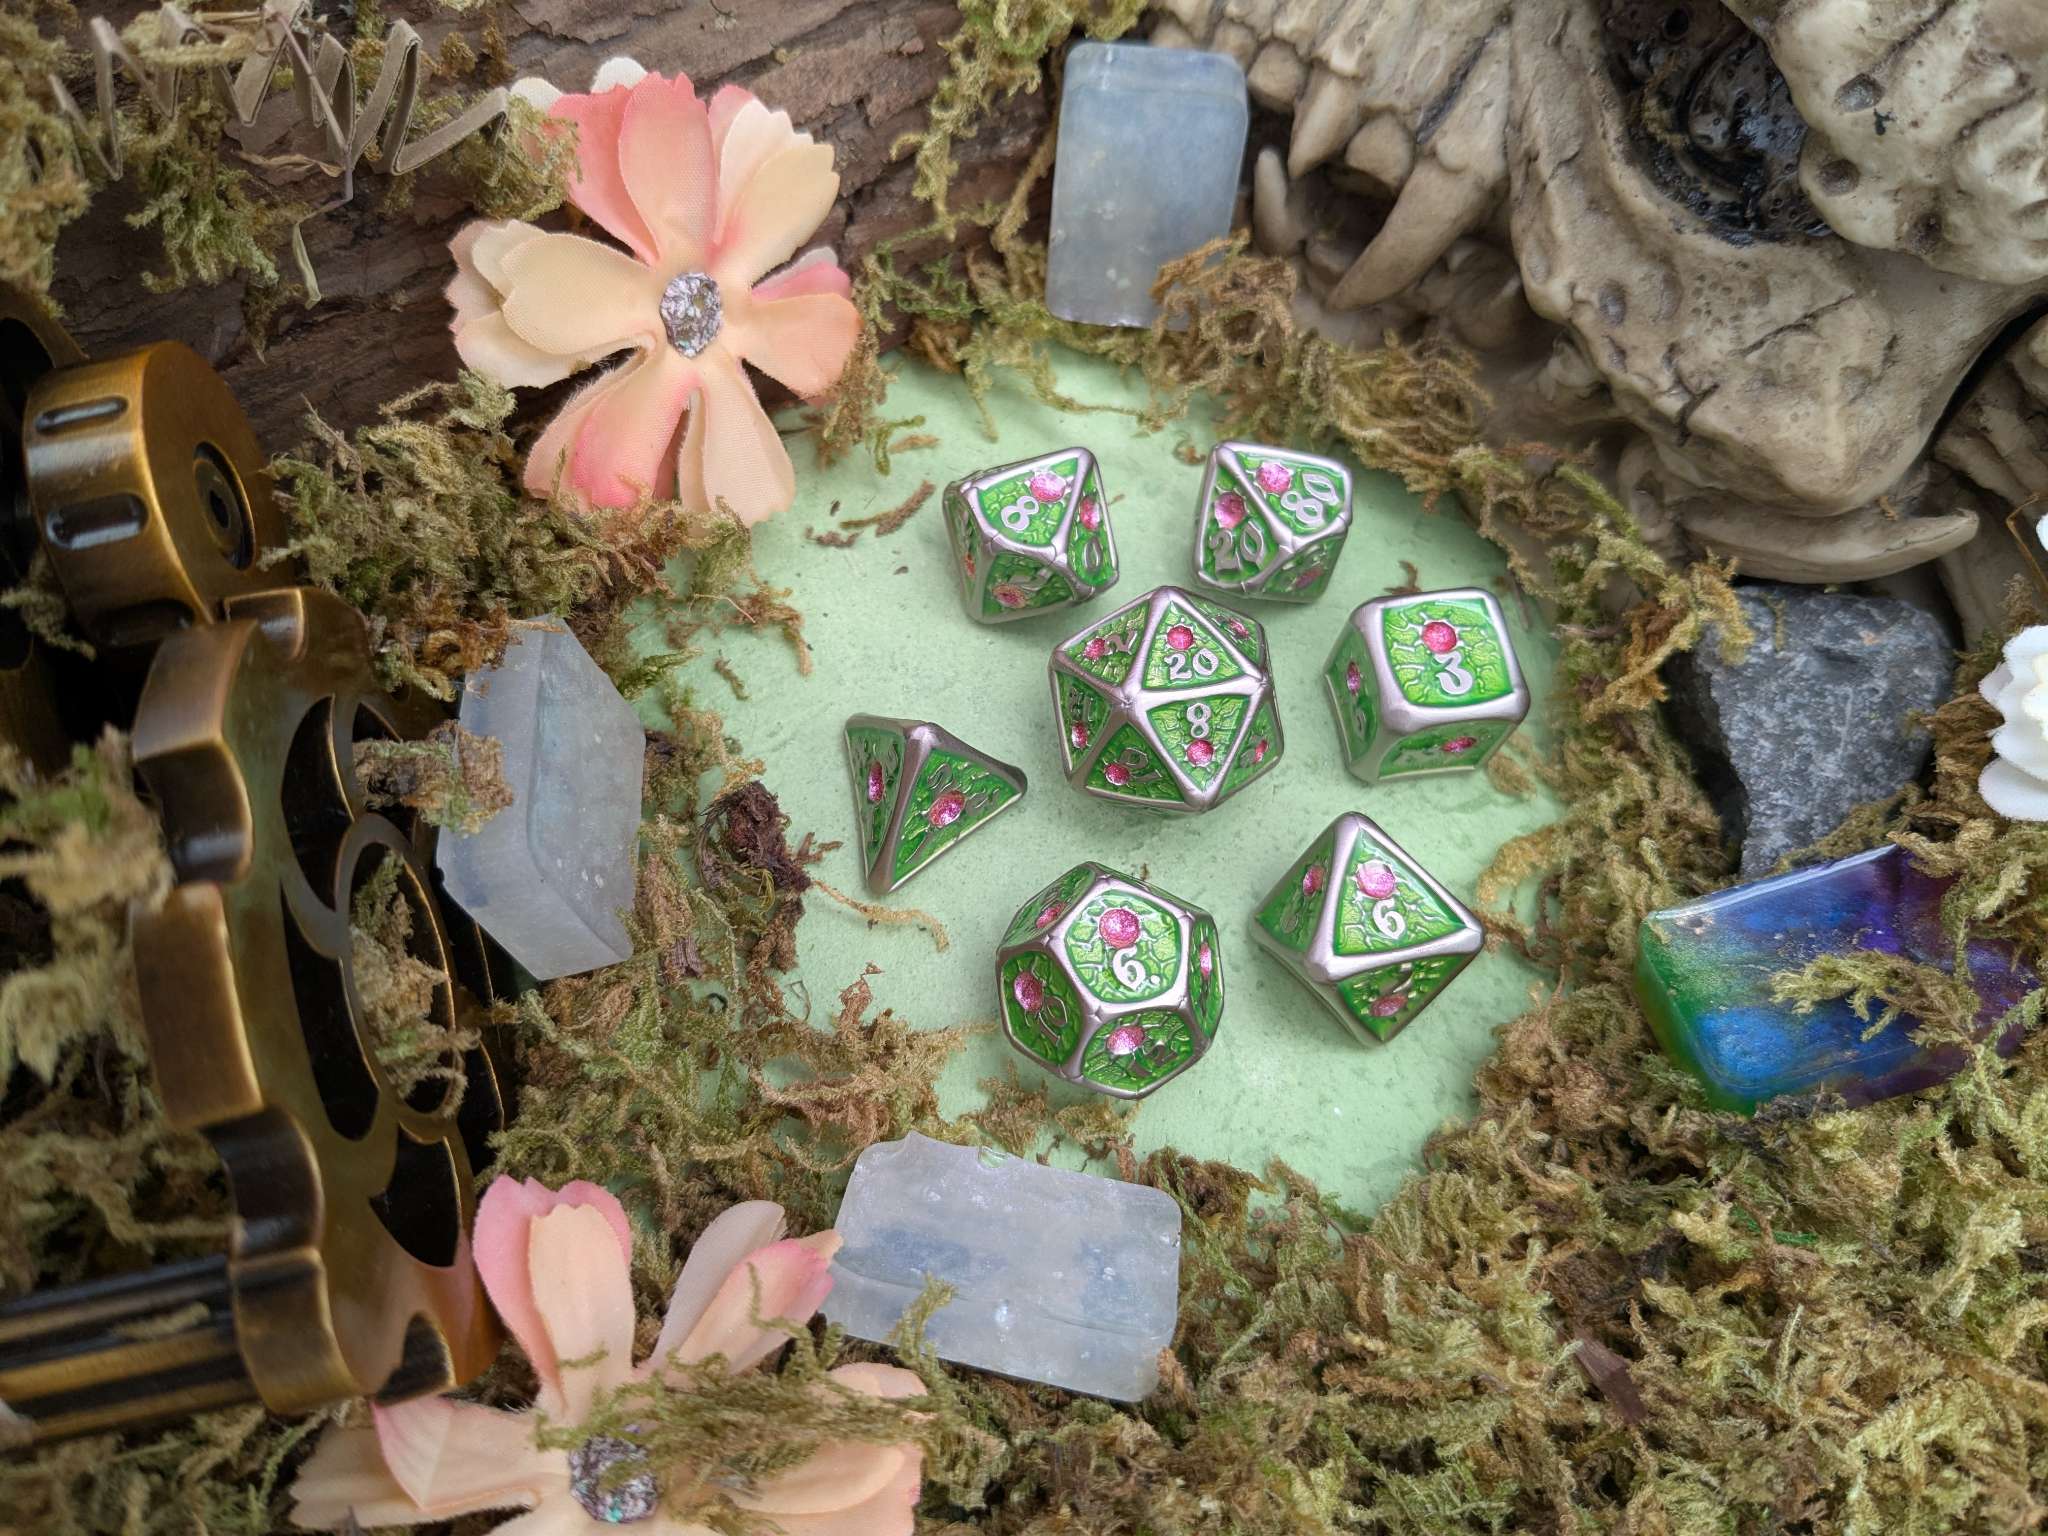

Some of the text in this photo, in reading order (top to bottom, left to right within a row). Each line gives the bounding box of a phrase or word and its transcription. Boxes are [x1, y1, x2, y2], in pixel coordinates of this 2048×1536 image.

[1001, 496, 1039, 531] 8
[1280, 473, 1340, 527] 80
[1209, 519, 1265, 572] 20
[1164, 648, 1219, 681] 20
[1433, 650, 1474, 695] 3
[1186, 702, 1212, 738] 8
[1372, 899, 1406, 940] 6
